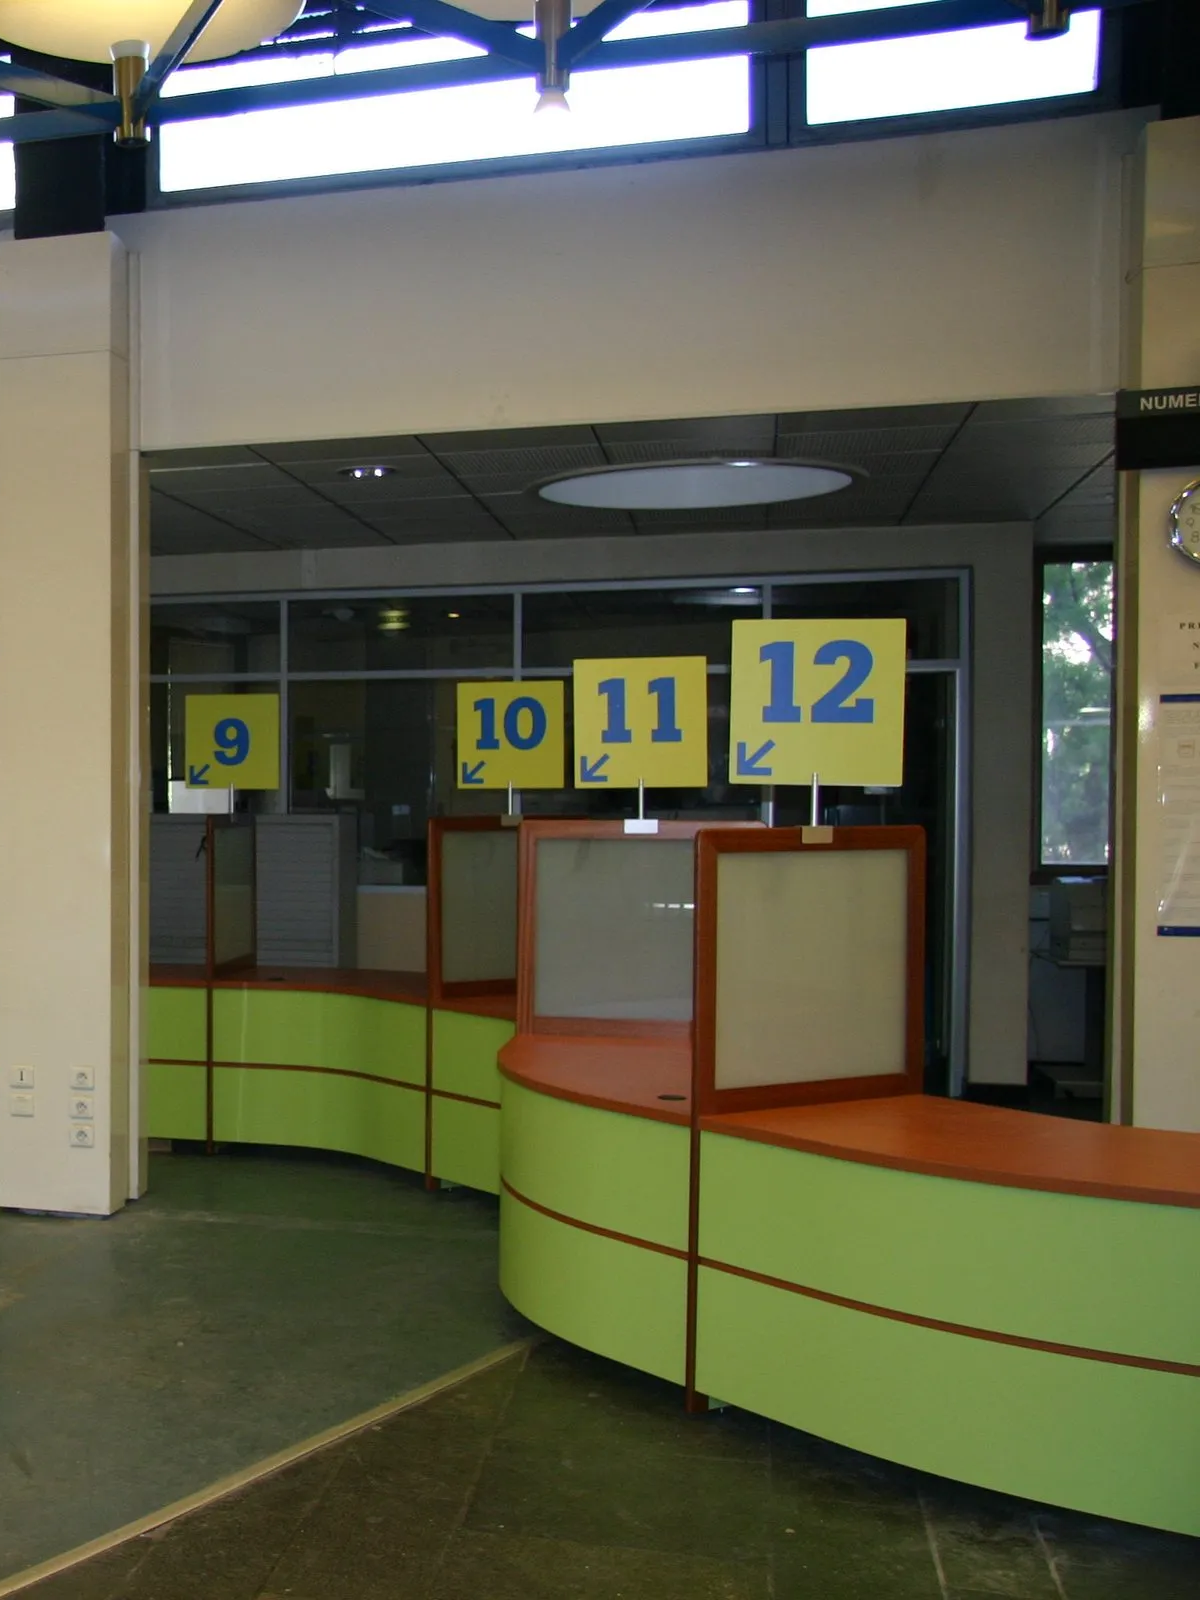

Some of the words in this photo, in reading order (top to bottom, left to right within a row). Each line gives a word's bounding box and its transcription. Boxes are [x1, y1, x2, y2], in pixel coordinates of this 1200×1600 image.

[1140, 393, 1200, 411] NUME
[760, 640, 875, 723] 12
[475, 697, 546, 750] 10
[599, 678, 682, 743] 11
[215, 718, 250, 765] 9
